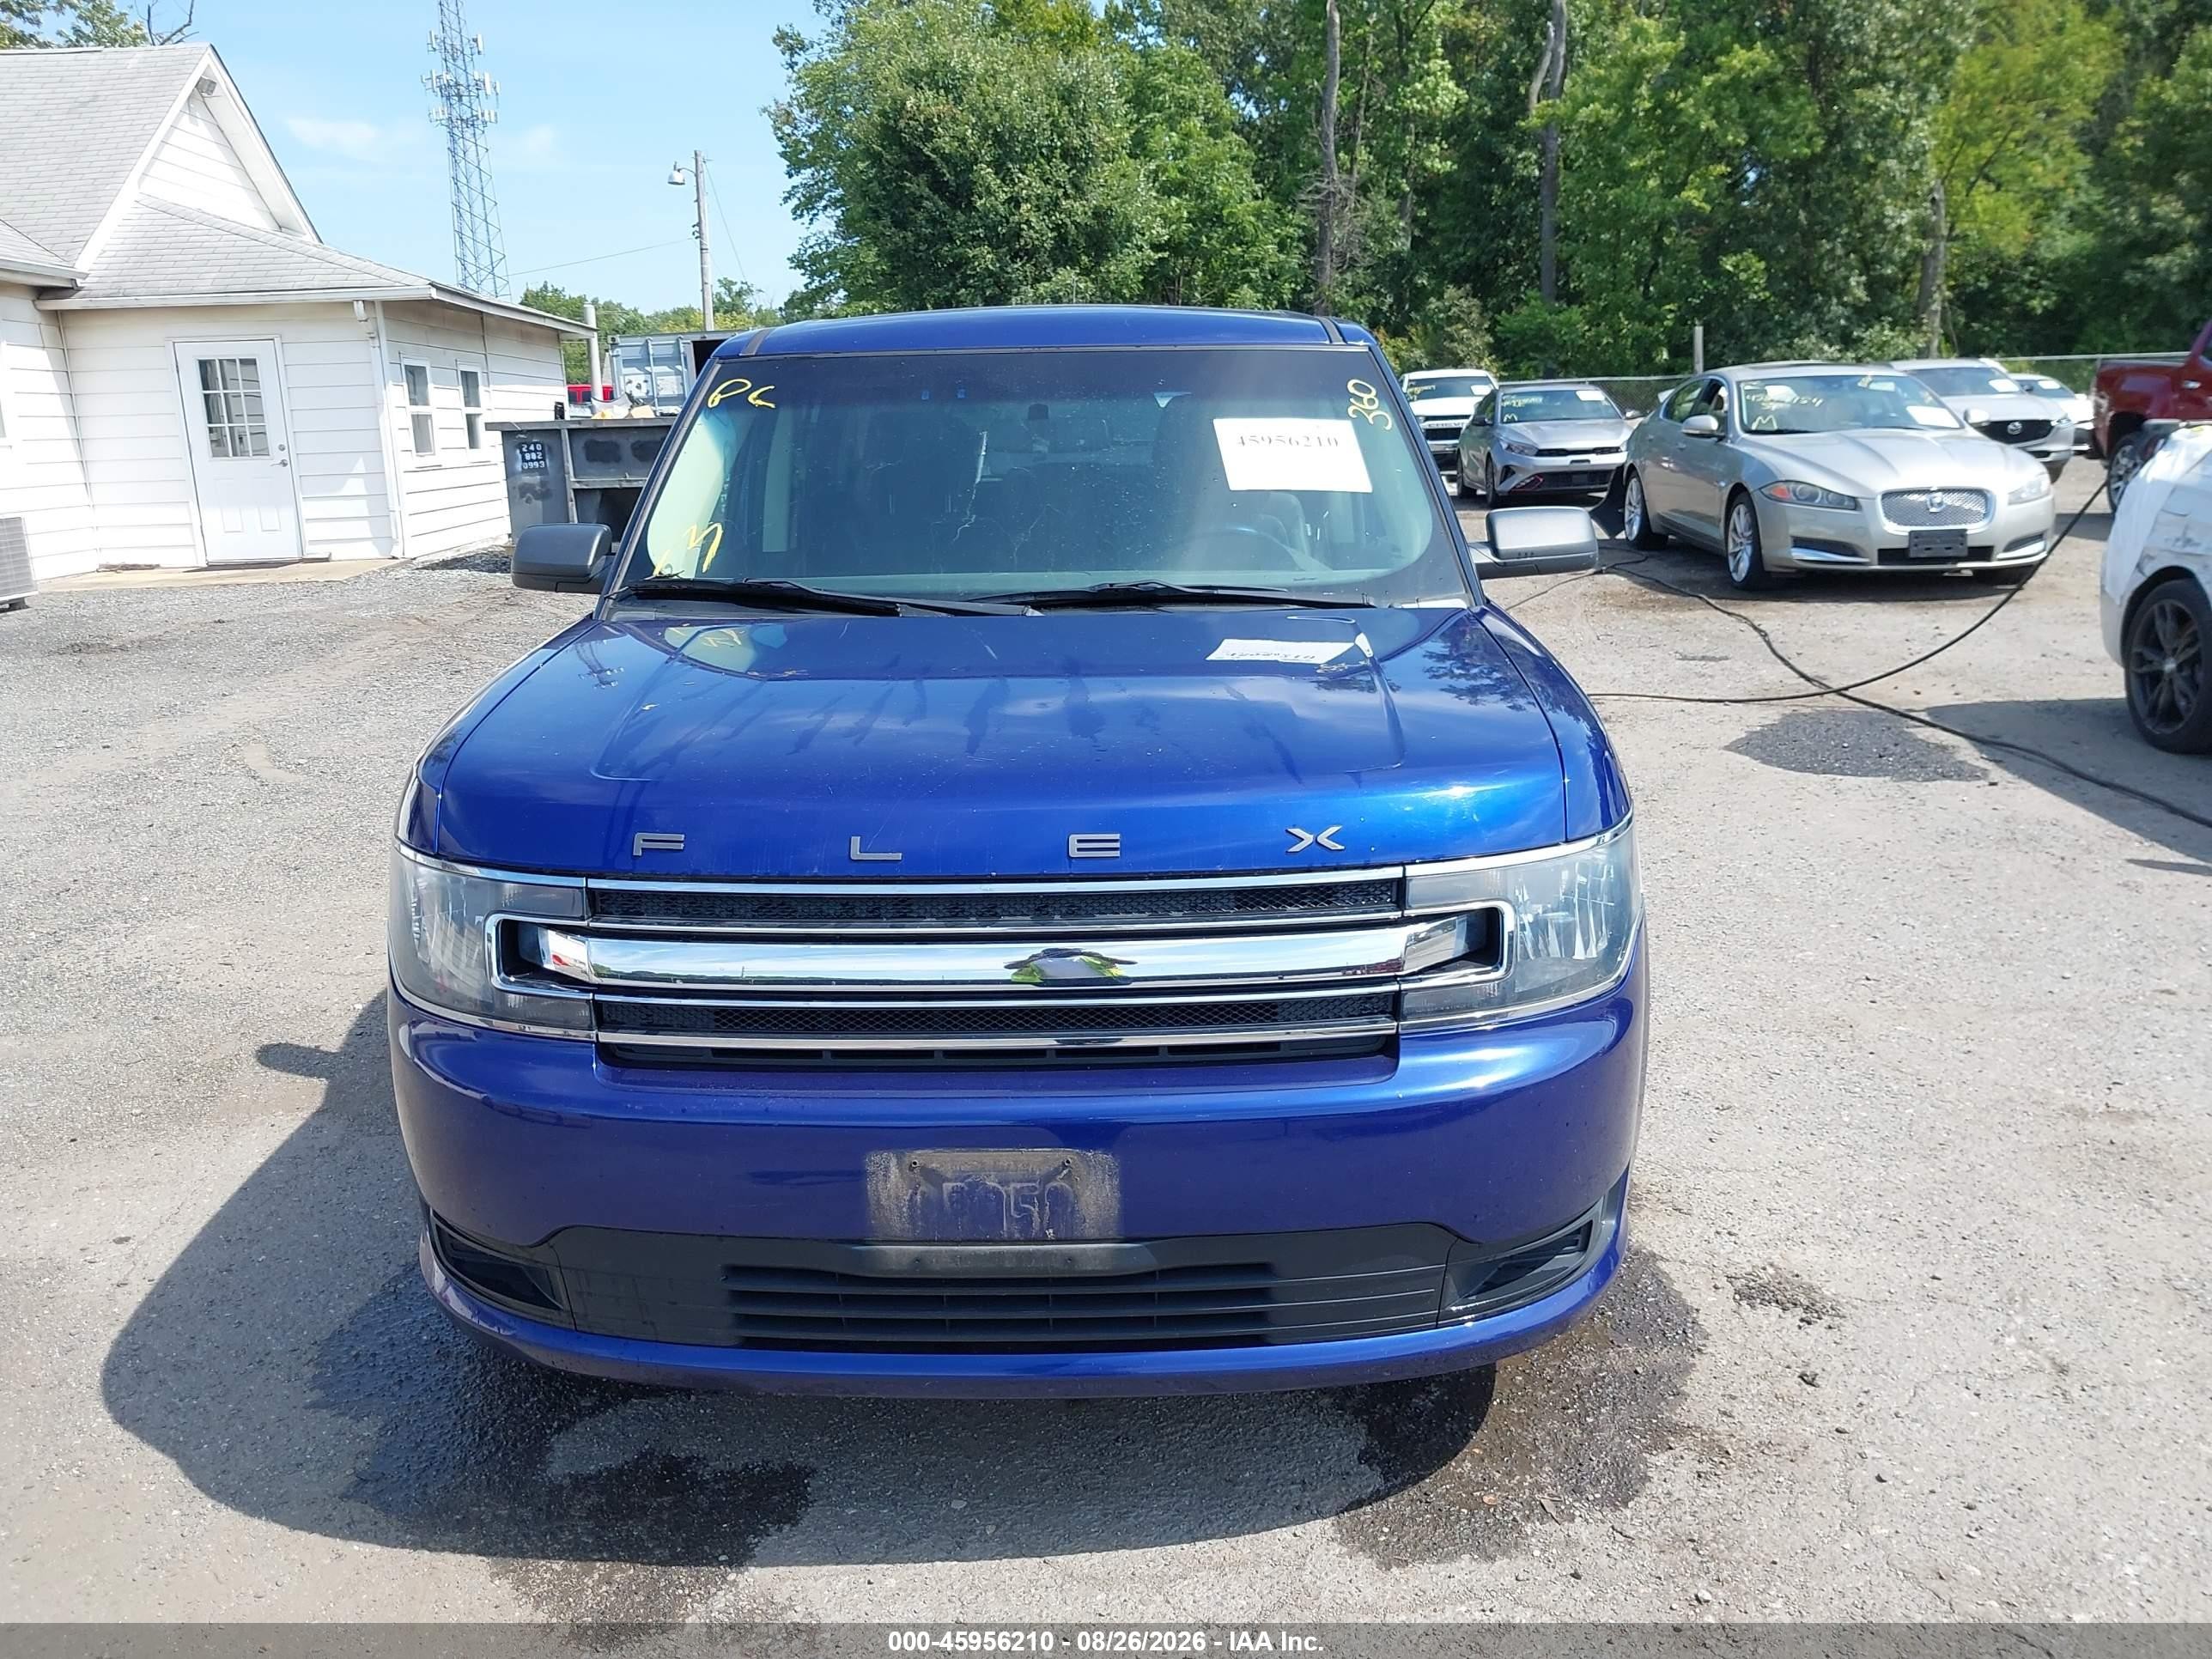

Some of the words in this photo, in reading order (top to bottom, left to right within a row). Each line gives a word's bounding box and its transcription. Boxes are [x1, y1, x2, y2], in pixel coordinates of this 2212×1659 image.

[1346, 379, 1393, 431] 360
[1751, 415, 1778, 430] M
[1237, 435, 1340, 447] 45956210
[521, 443, 543, 453] 240
[522, 460, 545, 470] 0993
[632, 823, 1346, 862] FLEX
